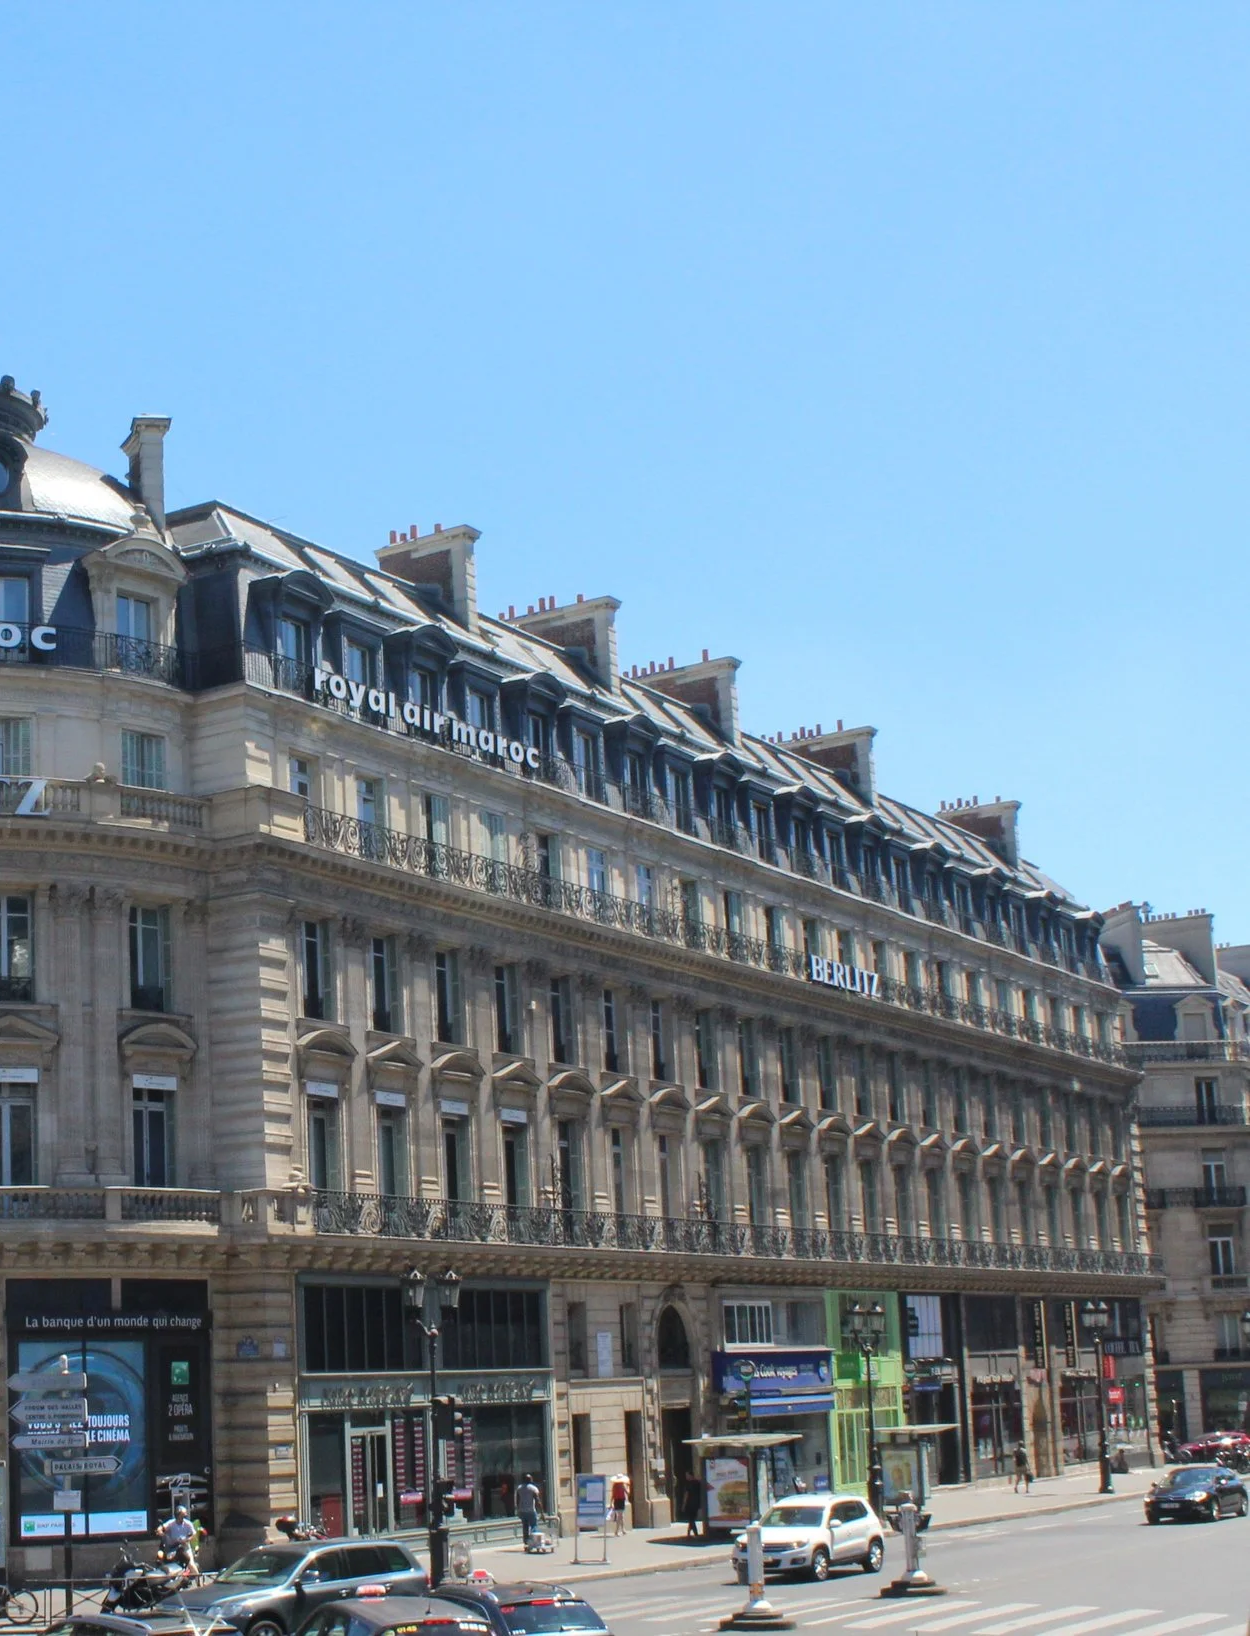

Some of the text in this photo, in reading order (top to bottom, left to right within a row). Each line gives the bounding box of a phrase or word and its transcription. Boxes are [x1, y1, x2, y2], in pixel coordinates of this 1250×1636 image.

[314, 667, 540, 769] royal air maroc
[810, 954, 881, 997] BERLITZ
[25, 1315, 202, 1330] La banque d'un monde qui change
[87, 1414, 130, 1428] TOUJOURS
[97, 1427, 130, 1443] CINÉMA
